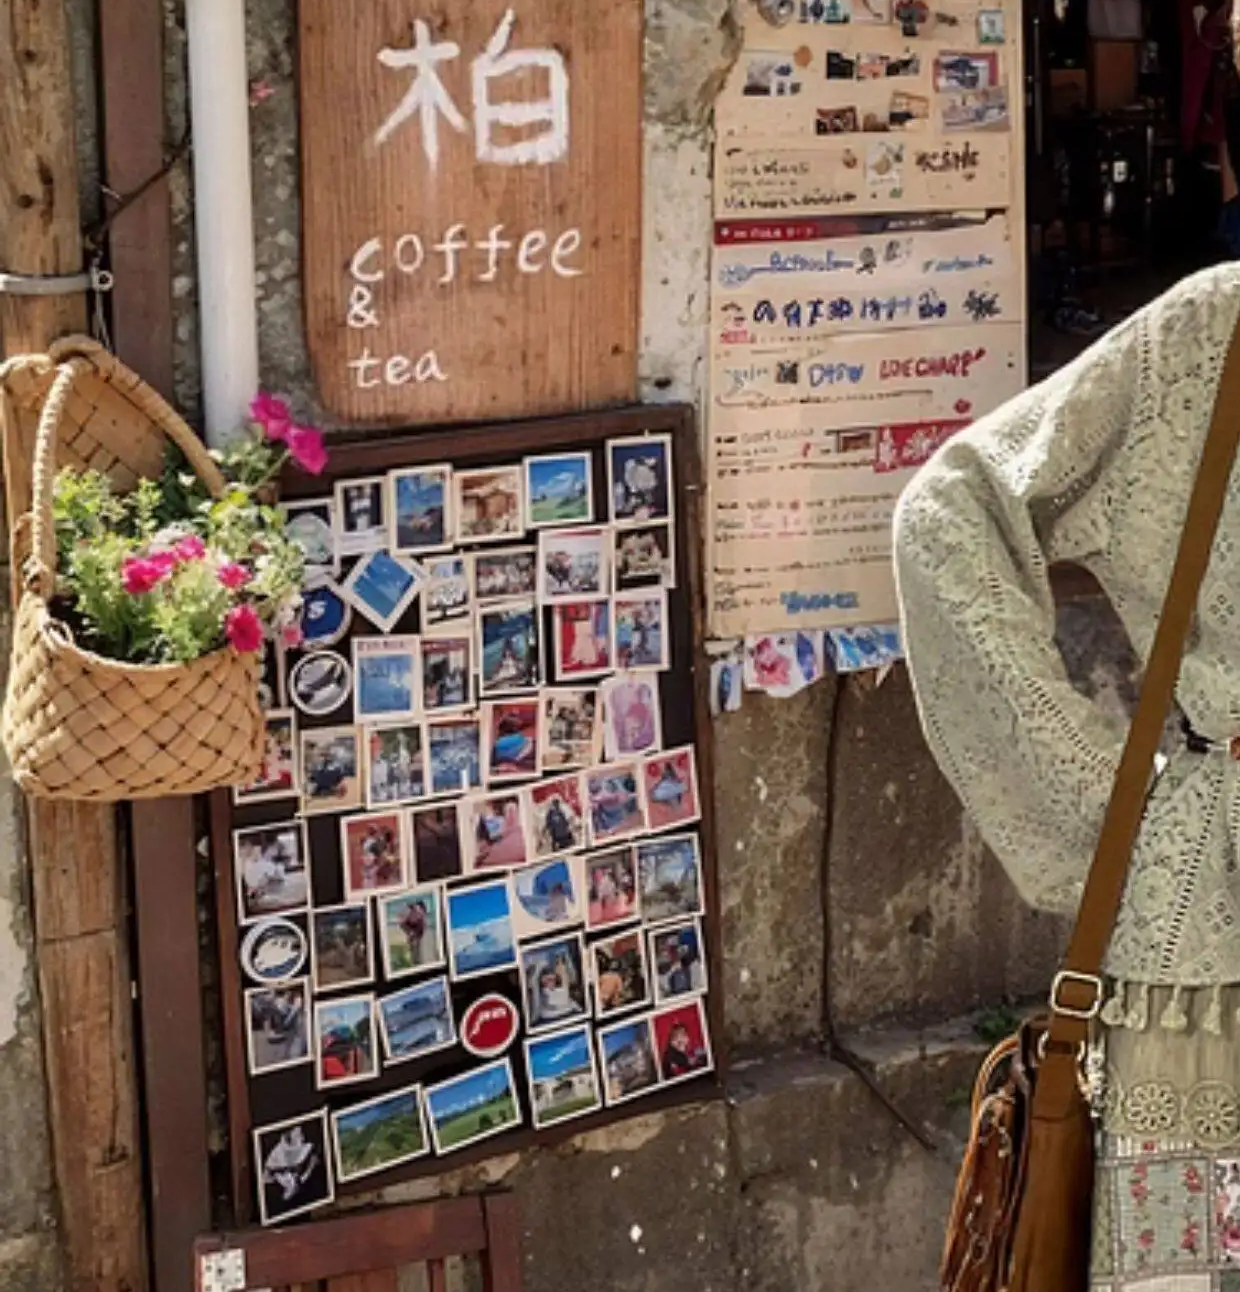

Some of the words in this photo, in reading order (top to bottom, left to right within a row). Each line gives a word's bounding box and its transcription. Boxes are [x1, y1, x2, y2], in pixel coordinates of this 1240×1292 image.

[351, 223, 583, 283] coffee
[347, 283, 380, 328] &
[348, 346, 449, 388] tea
